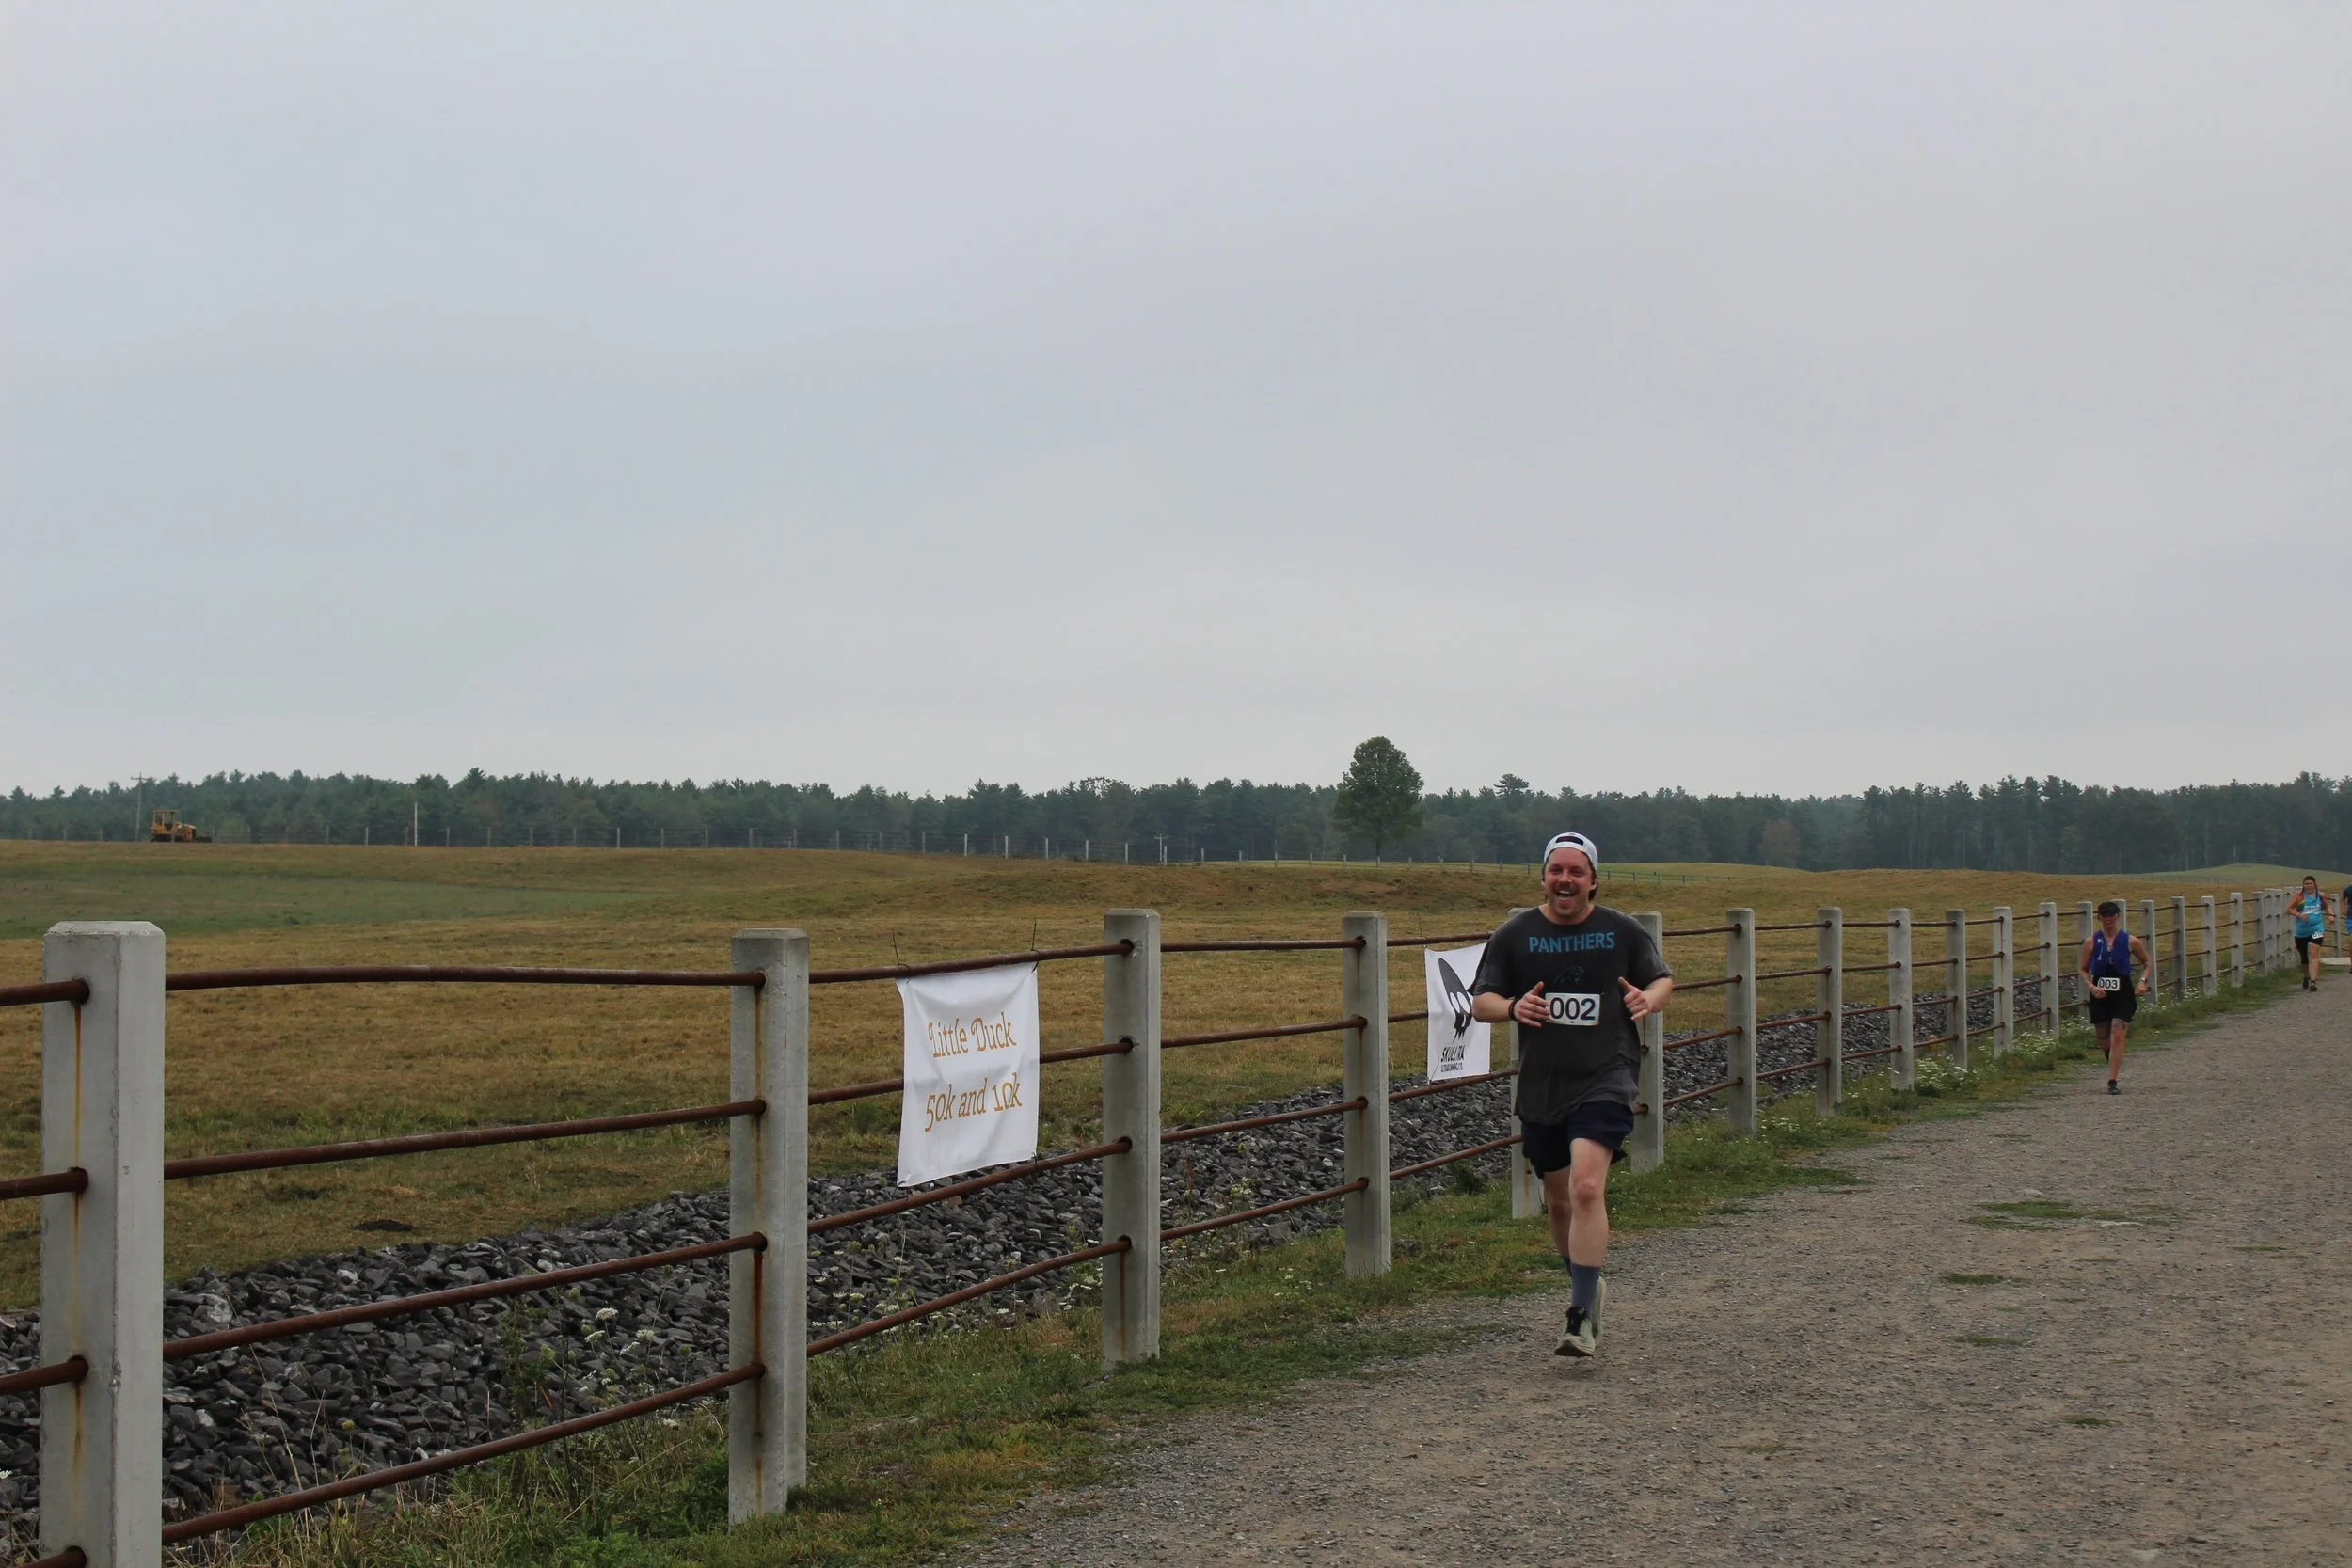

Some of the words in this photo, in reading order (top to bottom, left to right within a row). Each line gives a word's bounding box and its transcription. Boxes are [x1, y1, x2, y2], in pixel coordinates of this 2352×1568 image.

[1528, 931, 1615, 953] PANTHERS
[2098, 978, 2118, 990] 003
[1549, 996, 1597, 1021] 002
[928, 1017, 969, 1058] Little
[971, 1011, 1017, 1052] Duck
[924, 1083, 955, 1132] 50k
[958, 1076, 987, 1118] and
[992, 1072, 1023, 1112] 10k
